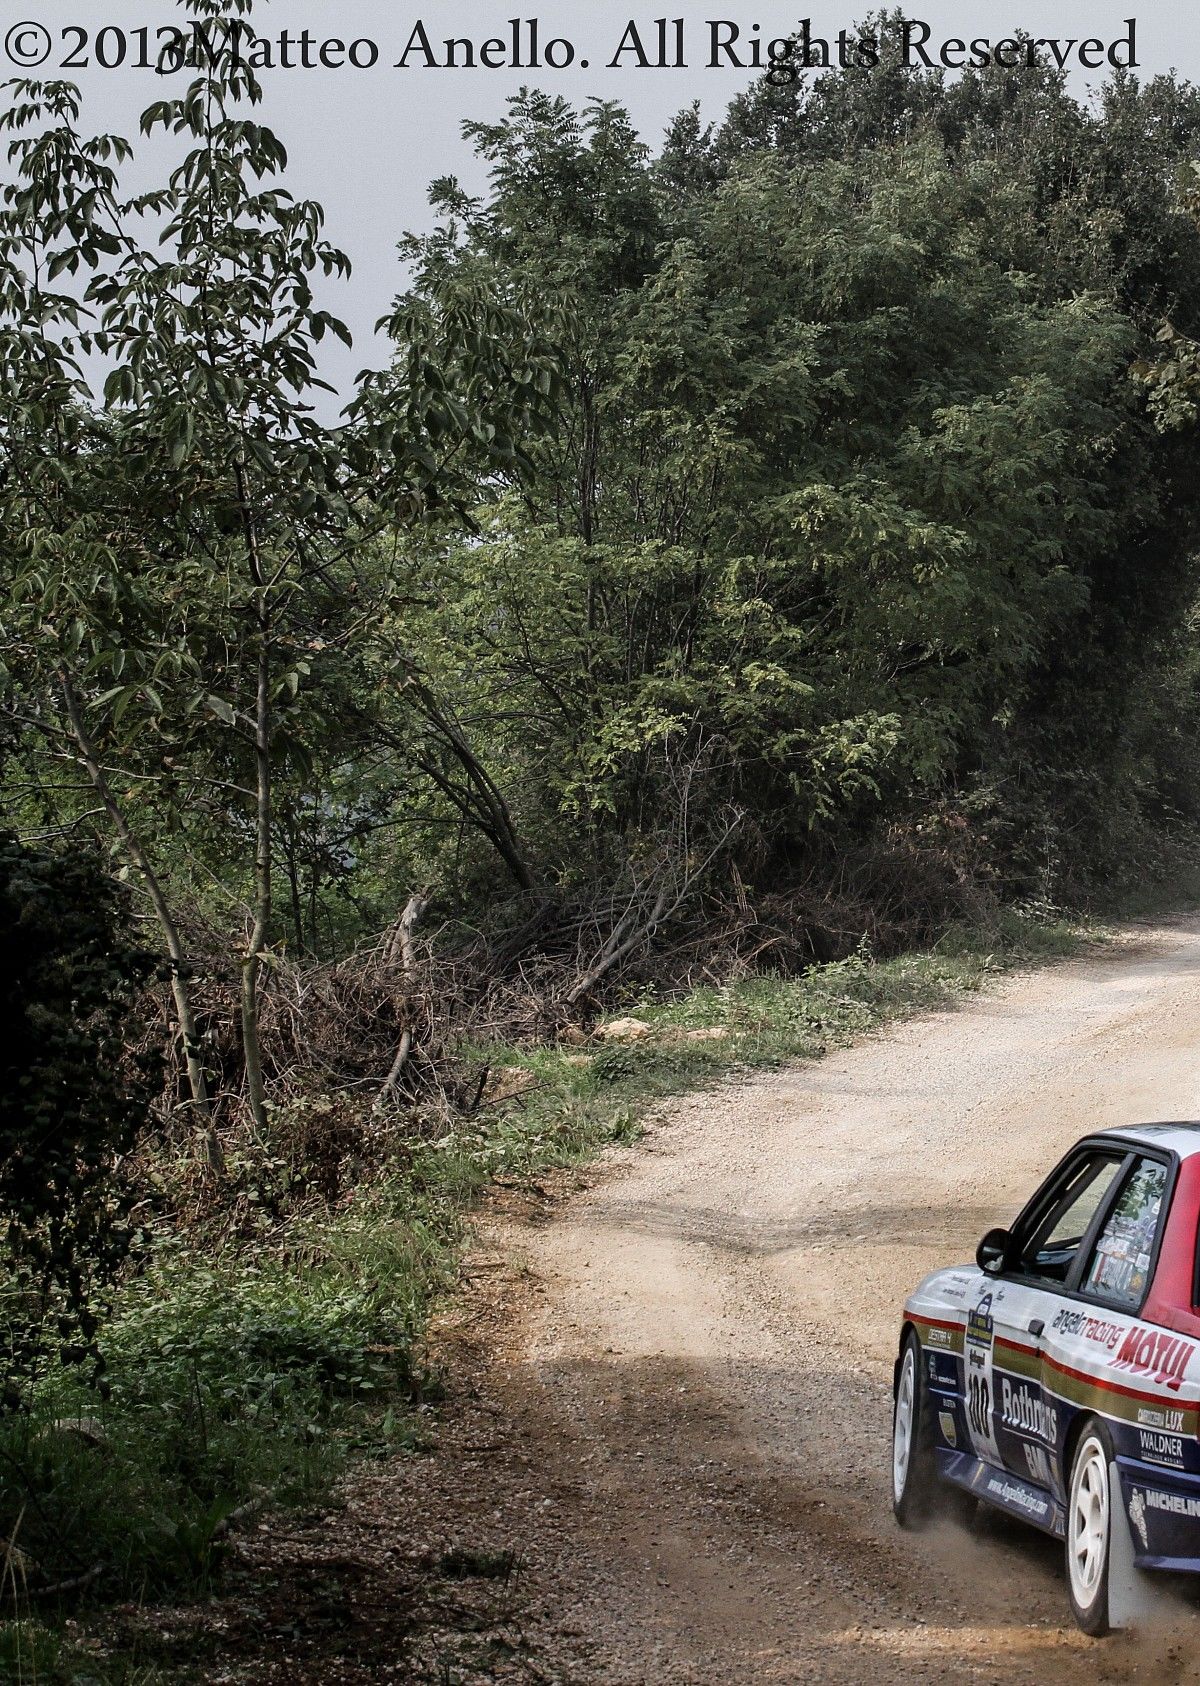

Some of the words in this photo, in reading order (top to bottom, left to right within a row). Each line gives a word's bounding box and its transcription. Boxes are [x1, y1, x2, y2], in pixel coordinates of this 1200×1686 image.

[1106, 1326, 1196, 1391] MOTUL
[1165, 1410, 1185, 1432] LUX
[1140, 1430, 1183, 1457] WALDNER
